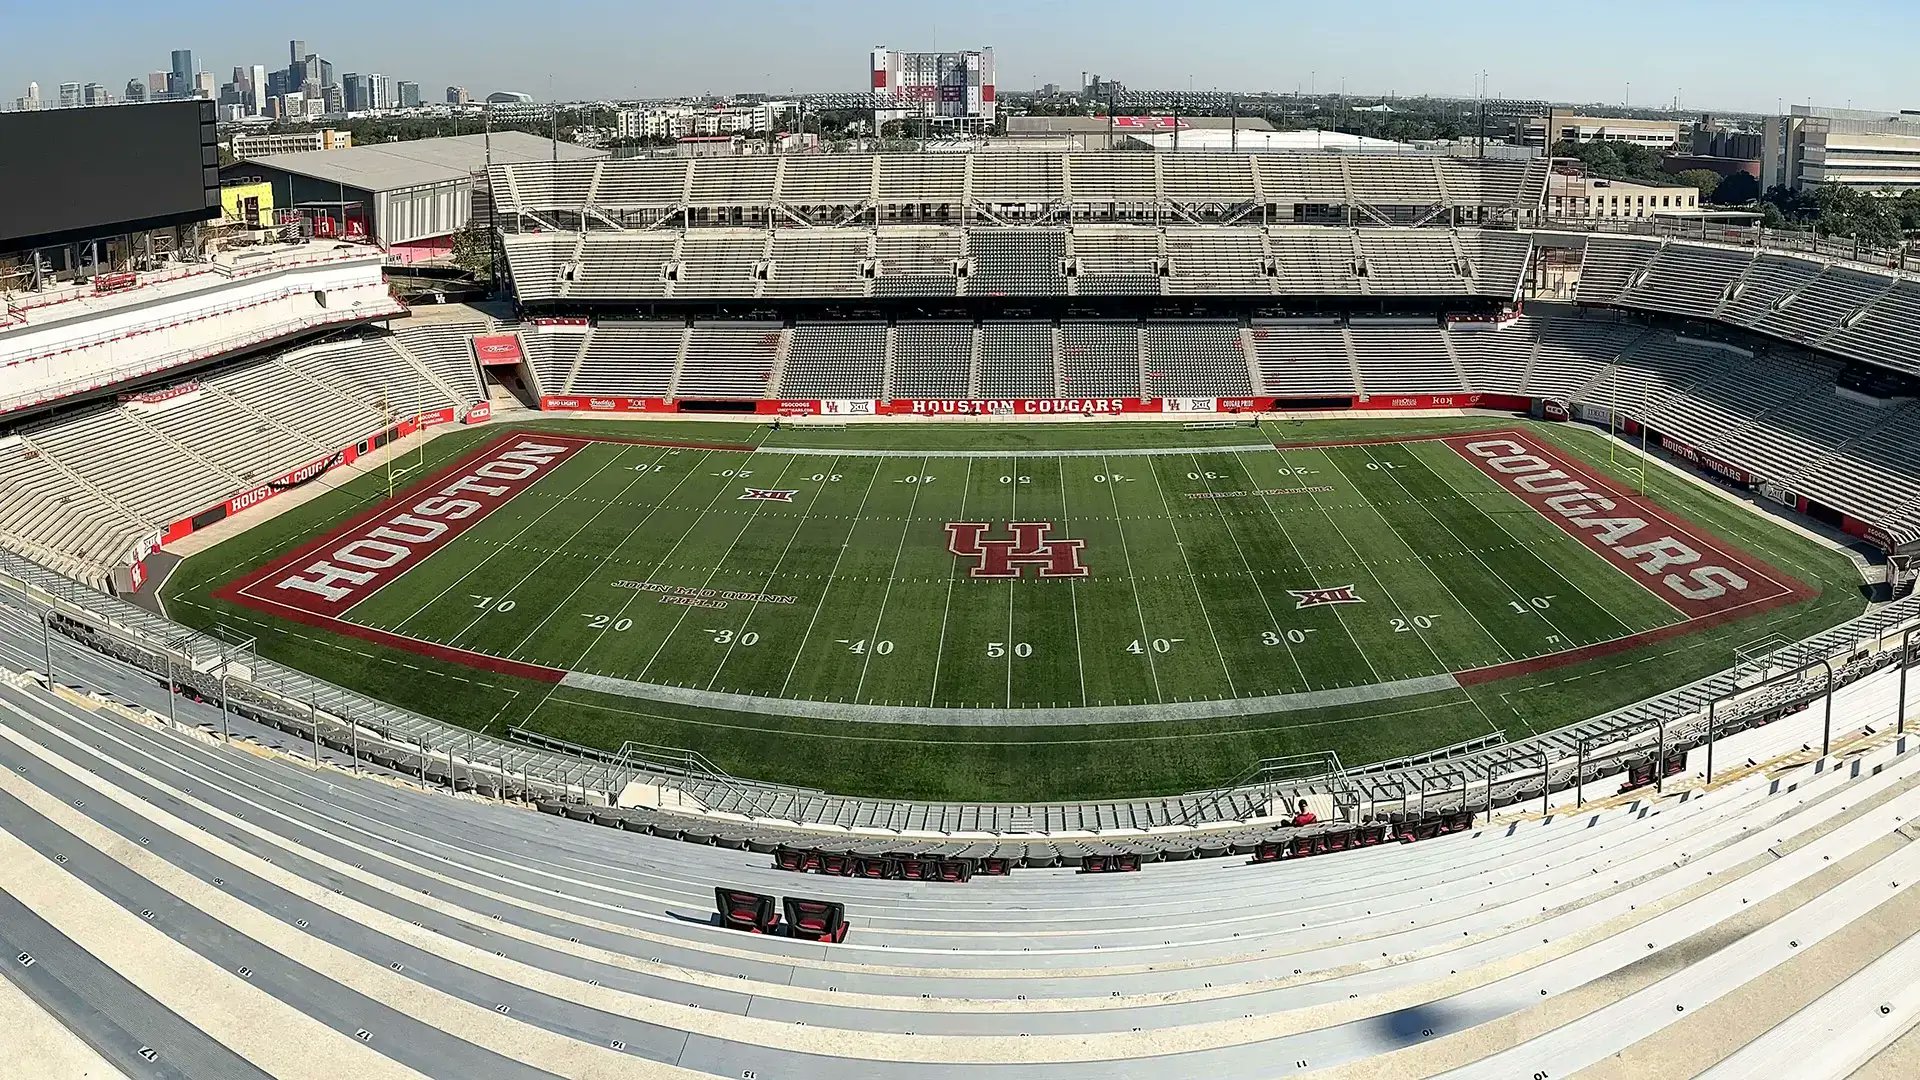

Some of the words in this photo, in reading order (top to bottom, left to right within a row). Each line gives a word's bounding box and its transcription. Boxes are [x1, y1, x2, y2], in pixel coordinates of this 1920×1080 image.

[826, 402, 838, 412] UH
[912, 400, 1014, 413] HOUSTON
[1024, 399, 1123, 413] COUGARS
[1168, 400, 1180, 410] UH
[1662, 437, 1699, 462] HOUSTON
[1701, 455, 1741, 481] COUGARS
[231, 477, 290, 511] HOUSTON
[294, 452, 344, 483] COUGARS
[745, 488, 794, 501] XII
[275, 441, 569, 602] HOUSTON
[1464, 440, 1749, 600] COUGARS
[944, 522, 1089, 577] UH
[474, 596, 516, 612] 10
[659, 594, 729, 609] FIELD
[1294, 586, 1357, 608] XII
[1508, 597, 1550, 614] 10
[588, 614, 632, 632] 20
[1390, 615, 1432, 633] 20
[714, 629, 760, 646] 30
[1261, 629, 1305, 646] 30
[848, 639, 894, 655] 40
[987, 642, 1033, 658] 50
[1126, 638, 1171, 655] 40
[18, 952, 33, 965] 18
[239, 966, 252, 976] 18
[496, 1005, 508, 1013] 17
[357, 1031, 369, 1039] 17
[1421, 1028, 1434, 1037] 10
[140, 1048, 157, 1061] 17
[1296, 1060, 1308, 1068] 11
[743, 1070, 755, 1079] 15
[1534, 1071, 1548, 1080] 10
